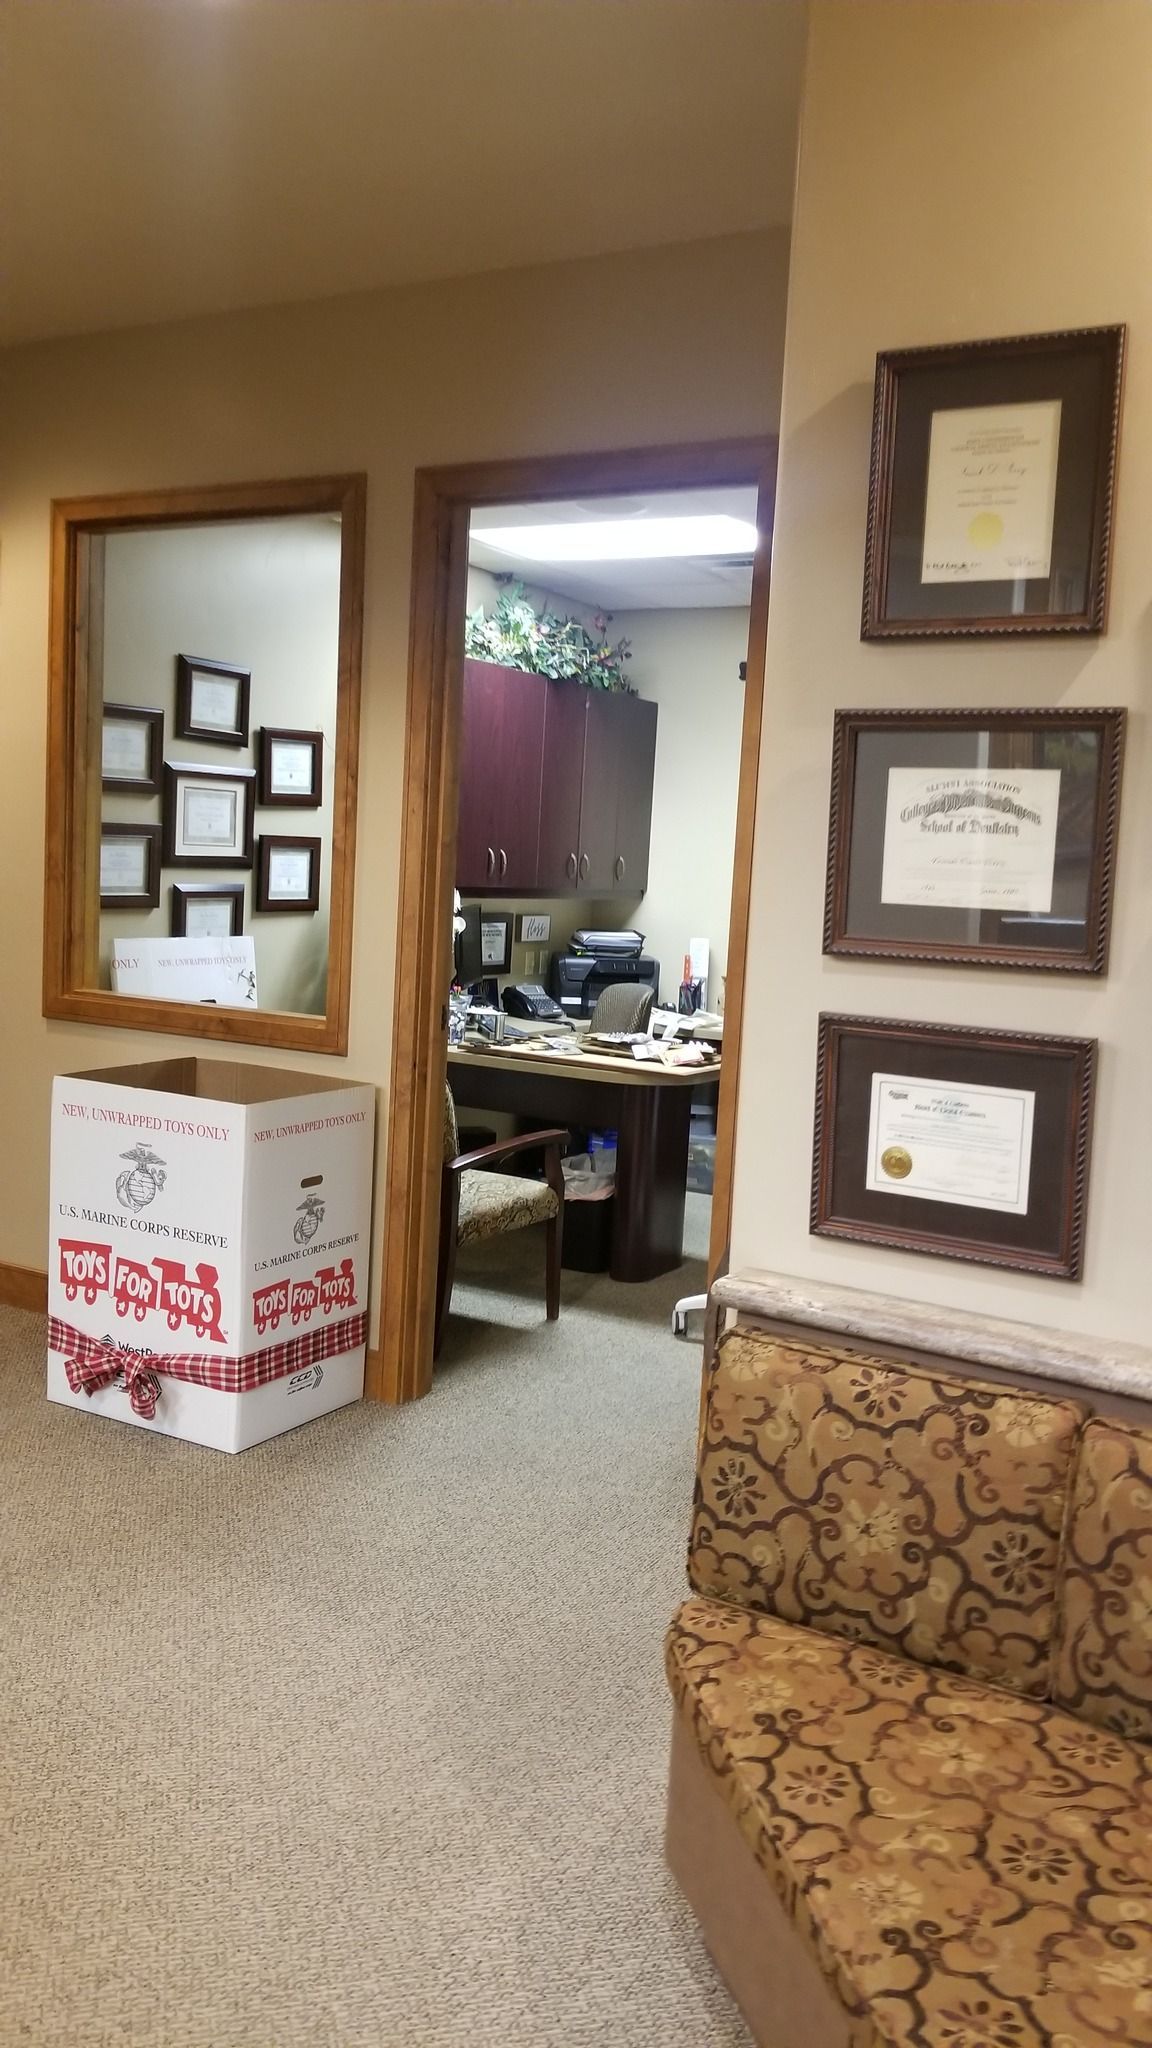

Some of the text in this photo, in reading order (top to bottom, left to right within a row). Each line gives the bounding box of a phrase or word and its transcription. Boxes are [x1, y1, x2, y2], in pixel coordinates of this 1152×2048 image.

[920, 819, 953, 834] School
[111, 958, 140, 970] ONLY
[62, 1103, 230, 1141] NEW, UNWRAPPED TOYS ONLY
[254, 1111, 367, 1142] NEW, UNWRAPPED TOYS ONLY
[59, 1204, 228, 1249] U.S. MARINE CORPS RESERVE
[254, 1233, 360, 1272] U.S. MARINE CORPS RESERVE
[62, 1250, 214, 1323] TOYS FOR TOTS
[255, 1277, 351, 1318] TOYS FOR TOTS
